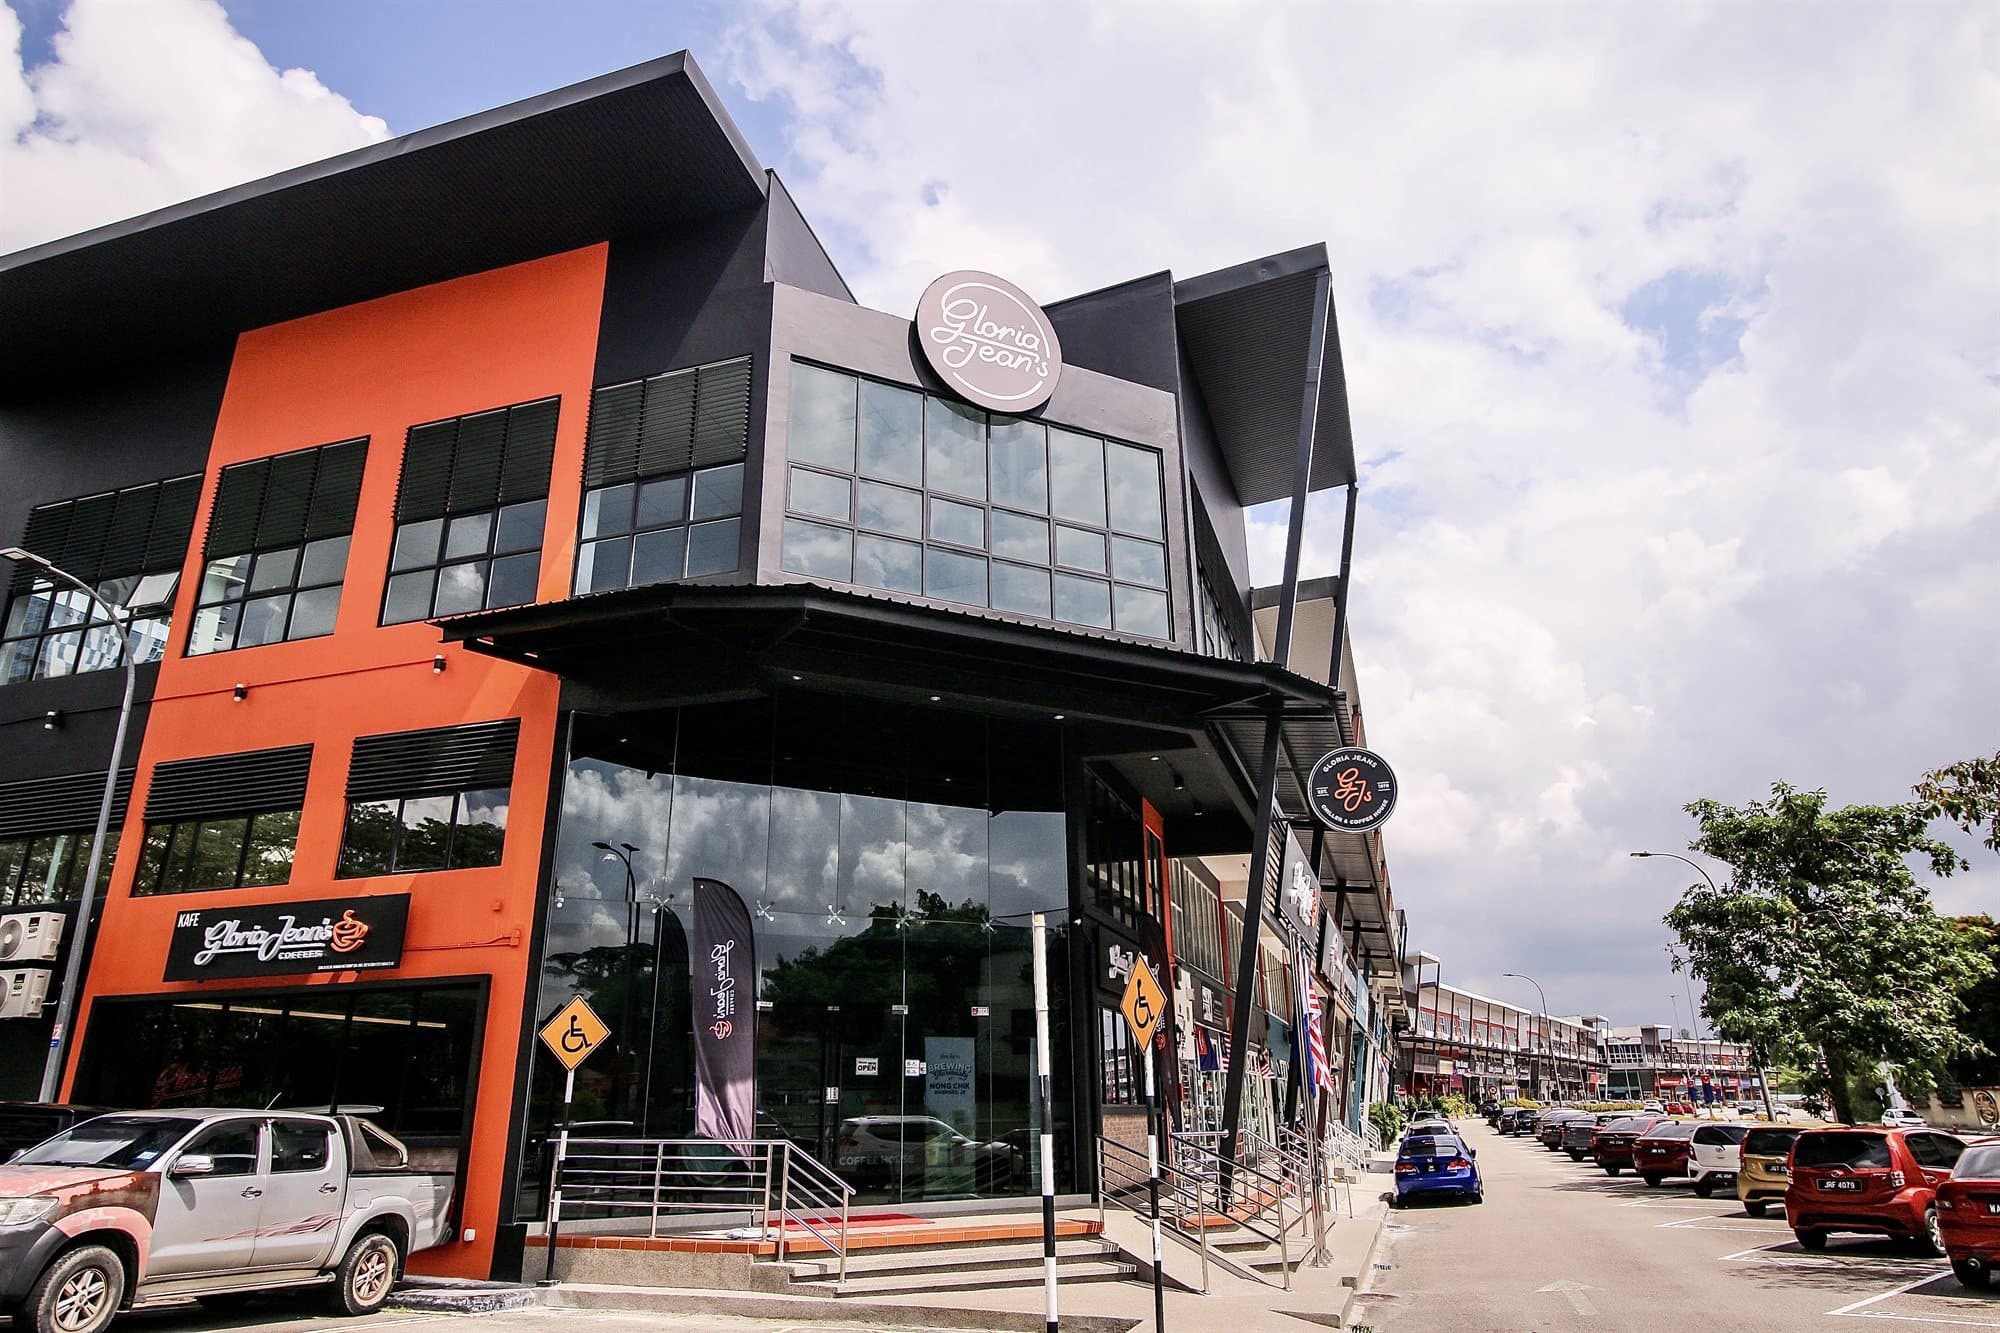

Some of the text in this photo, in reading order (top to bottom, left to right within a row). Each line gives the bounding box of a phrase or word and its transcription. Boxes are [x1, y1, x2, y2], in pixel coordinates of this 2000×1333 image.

[930, 298, 1040, 351] Gloria
[943, 339, 1048, 377] Jean's
[1323, 755, 1377, 772] GLORIA JEANS
[1349, 815, 1374, 825] COFFEE
[1372, 799, 1388, 817] HOUSE
[178, 912, 200, 928] KAFE
[194, 915, 334, 965] Gloria Jean's
[711, 940, 735, 1019] Gloria Jean's
[857, 1064, 877, 1072] OPEN
[928, 1062, 971, 1073] BREWING
[929, 1082, 970, 1090] NONG CHIK
[839, 1154, 879, 1166] COFFEE
[1824, 1181, 1855, 1189] JRF 4079
